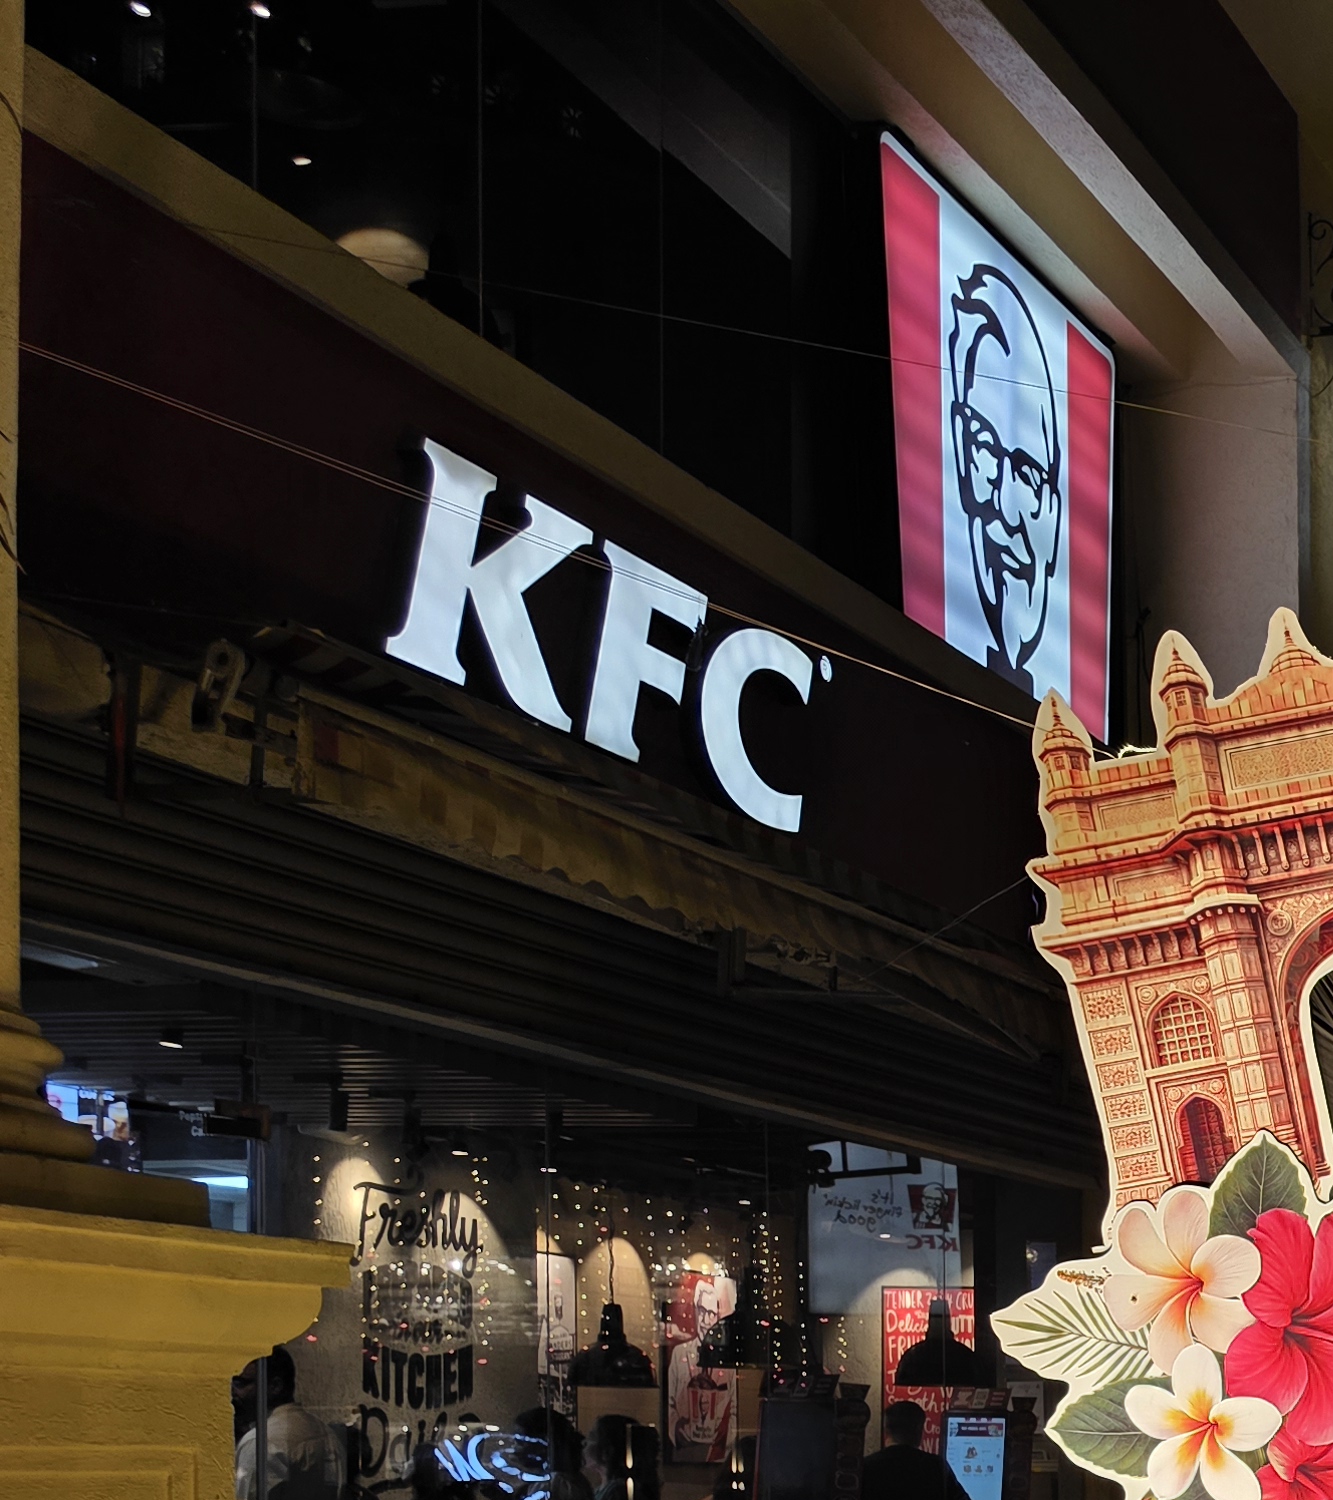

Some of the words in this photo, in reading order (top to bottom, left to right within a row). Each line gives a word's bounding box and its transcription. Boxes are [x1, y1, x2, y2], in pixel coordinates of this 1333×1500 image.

[385, 437, 812, 833] KFC
[350, 1168, 483, 1279] Freshly
[884, 1291, 924, 1310] TENDER
[362, 1337, 474, 1409] KITCHEN
